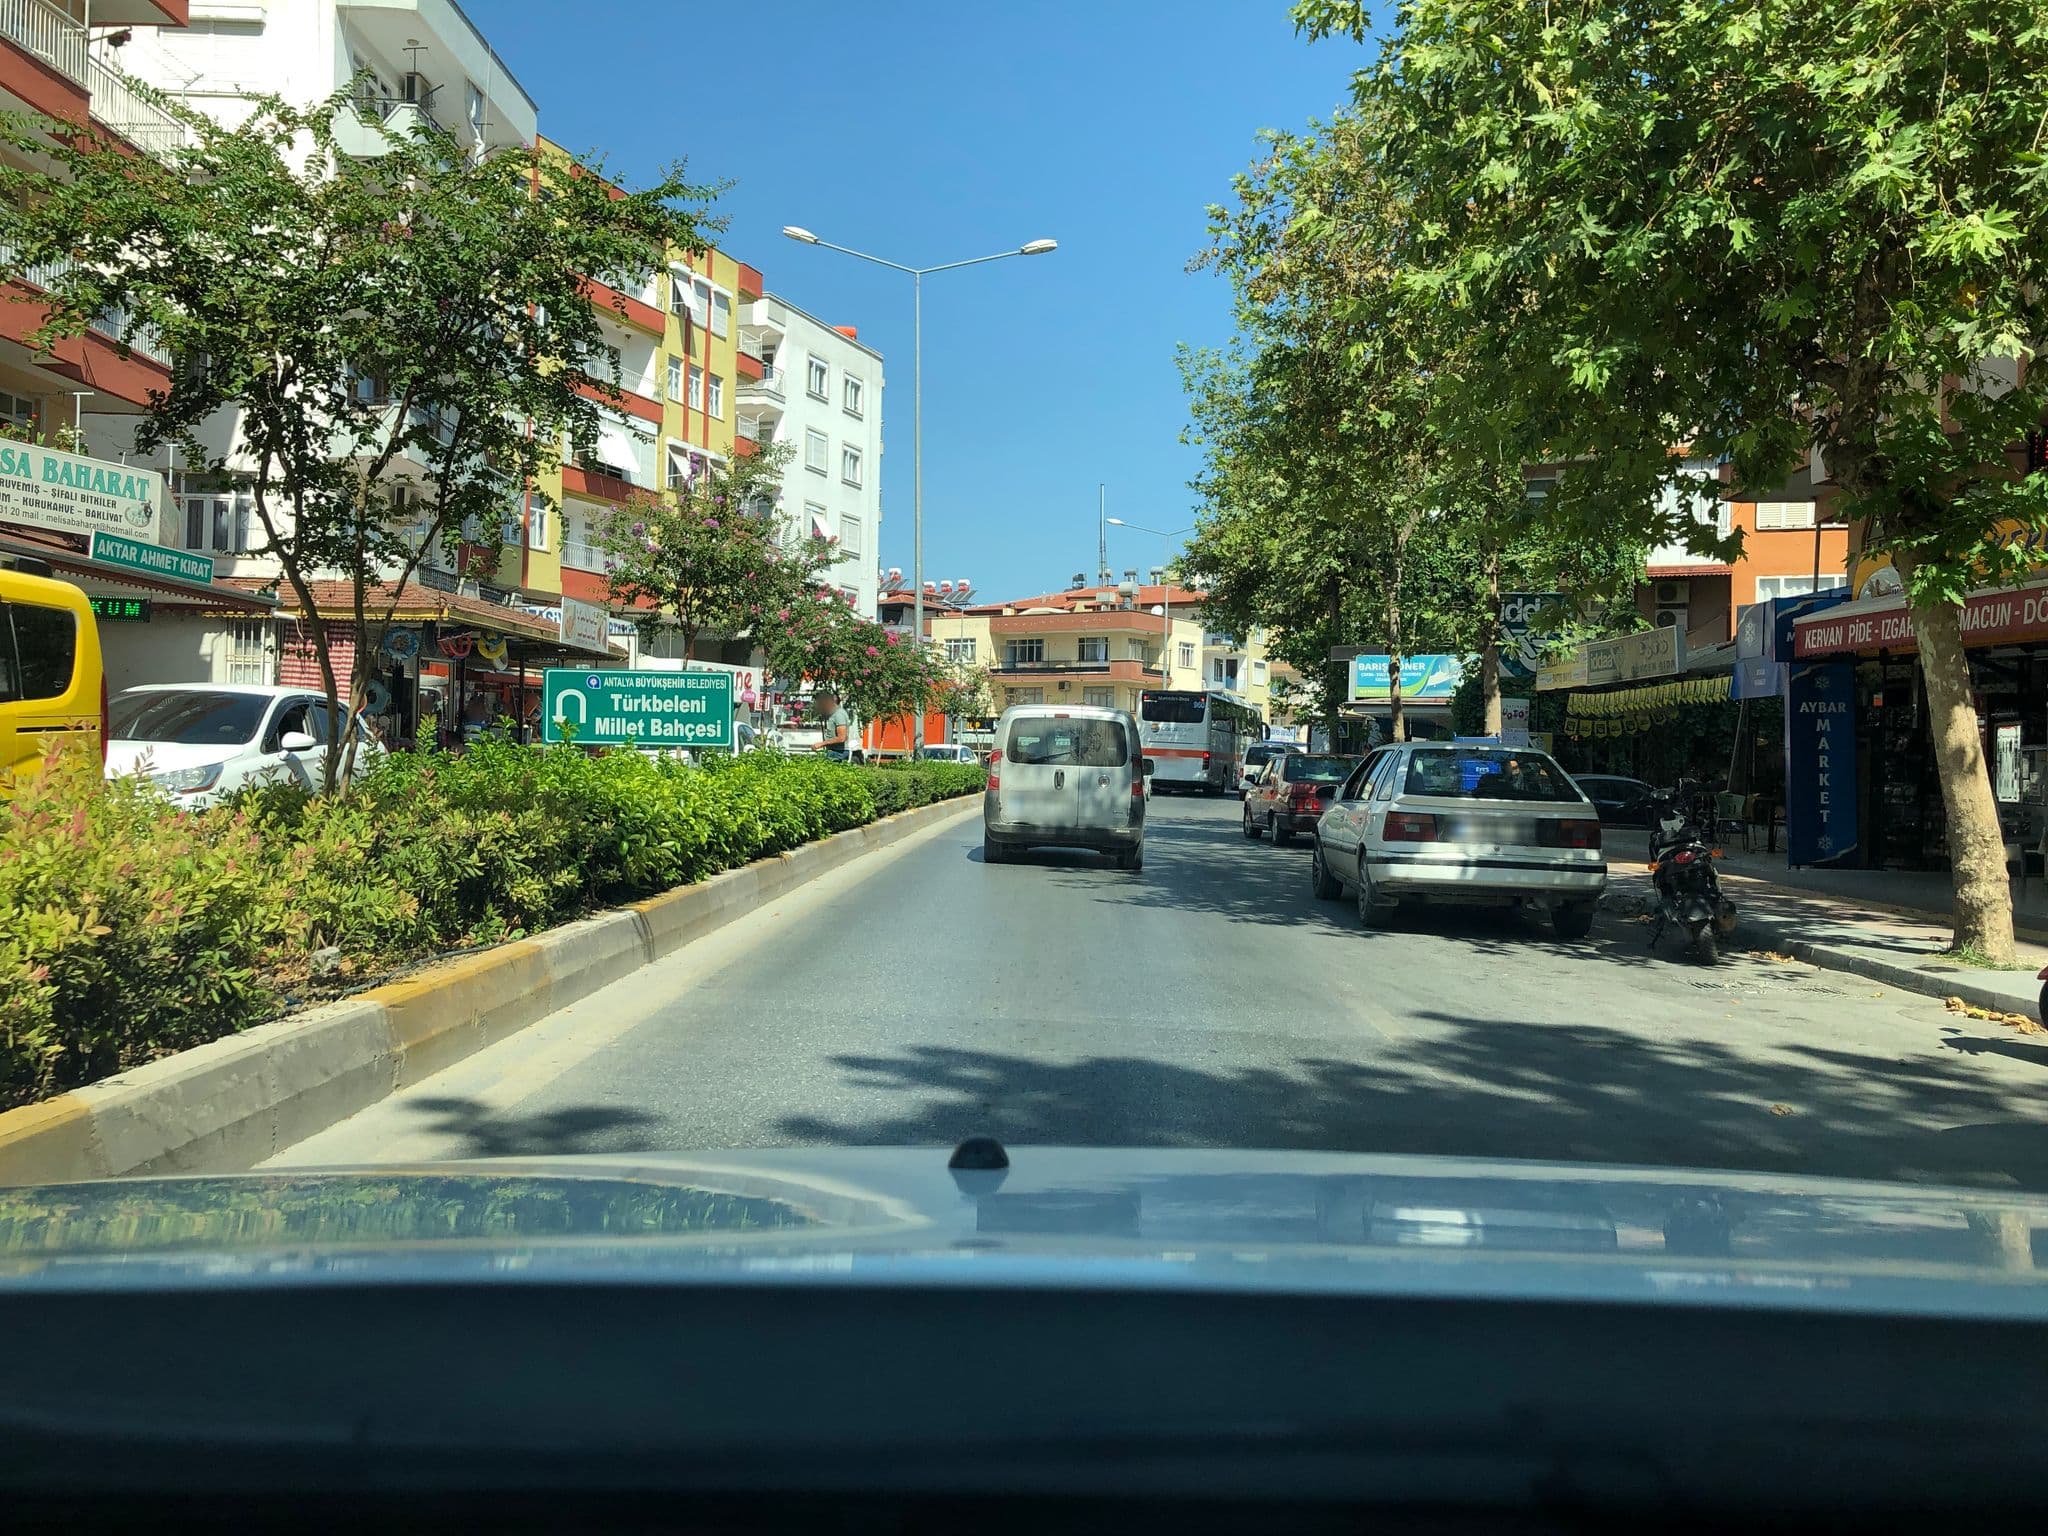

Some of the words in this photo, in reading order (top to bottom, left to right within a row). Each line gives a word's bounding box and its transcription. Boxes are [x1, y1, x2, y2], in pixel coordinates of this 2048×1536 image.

[42, 456, 150, 502] BAHARAT
[22, 497, 75, 515] KURUKAHVE
[51, 488, 78, 501] ŞİFALI
[80, 494, 117, 510] BİTKİLER
[10, 507, 20, 517] 20
[22, 510, 39, 520] mail
[46, 513, 150, 539] melisabaharat@hotmail.com
[97, 539, 138, 562] AKTAR
[140, 549, 179, 571] AHMET
[180, 558, 211, 578] KIRAT
[1805, 625, 1843, 649] KERVAN
[1848, 619, 1873, 644] PİDE
[603, 677, 634, 688] ANTALYA
[635, 675, 685, 690] BÜYÜKŞEHİR
[686, 677, 727, 689] BELEDİYESİ
[610, 693, 706, 713] Türkbeleni
[1800, 701, 1847, 713] AYBAR
[595, 717, 645, 736] Millet
[650, 719, 722, 741] Bahçesi
